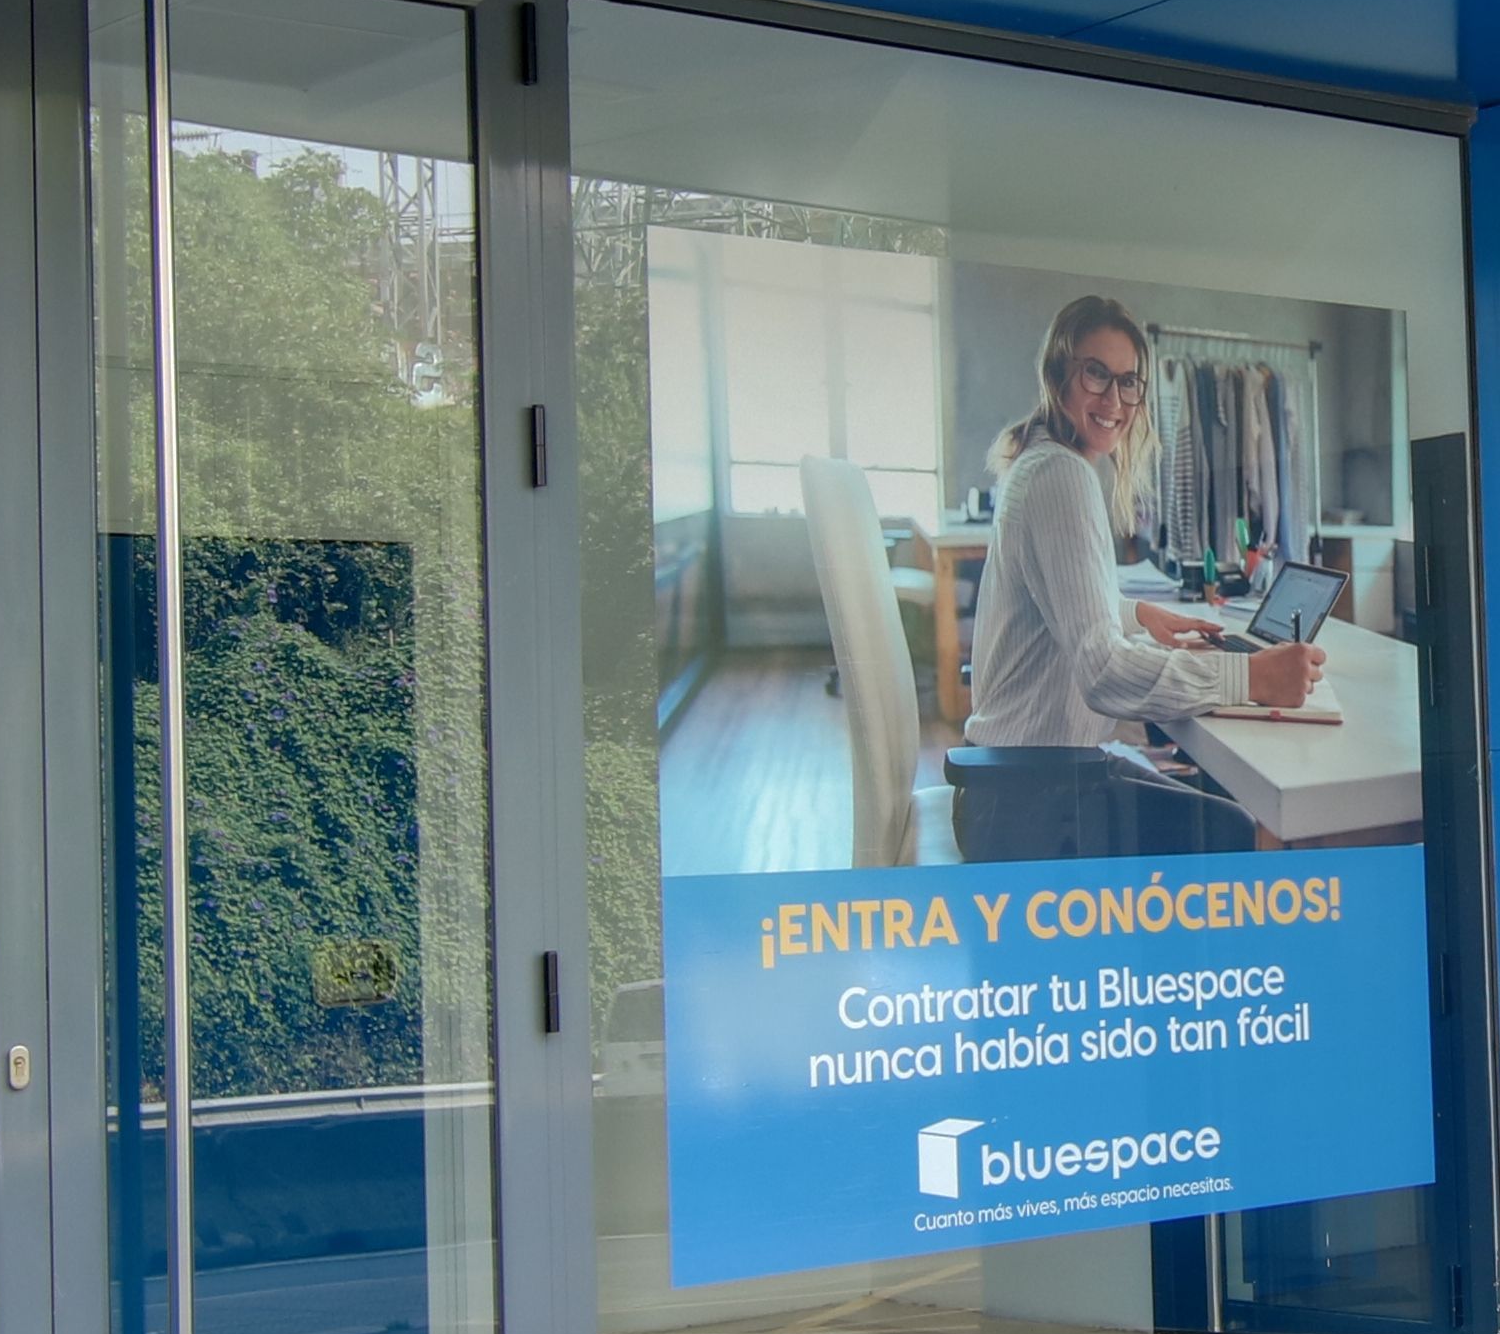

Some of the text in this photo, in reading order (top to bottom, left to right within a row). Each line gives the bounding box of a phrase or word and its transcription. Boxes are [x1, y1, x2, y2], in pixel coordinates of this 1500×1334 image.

[760, 872, 1342, 969] ¡ENTRA Y CONÓCENOS!
[837, 962, 1285, 1030] Contratar tu Bluespace
[810, 1002, 1311, 1088] nunca había sido tan fácil
[981, 1126, 1221, 1187] bluespace
[914, 1175, 1234, 1233] Cuanto más vives, más espacio necesitas.
